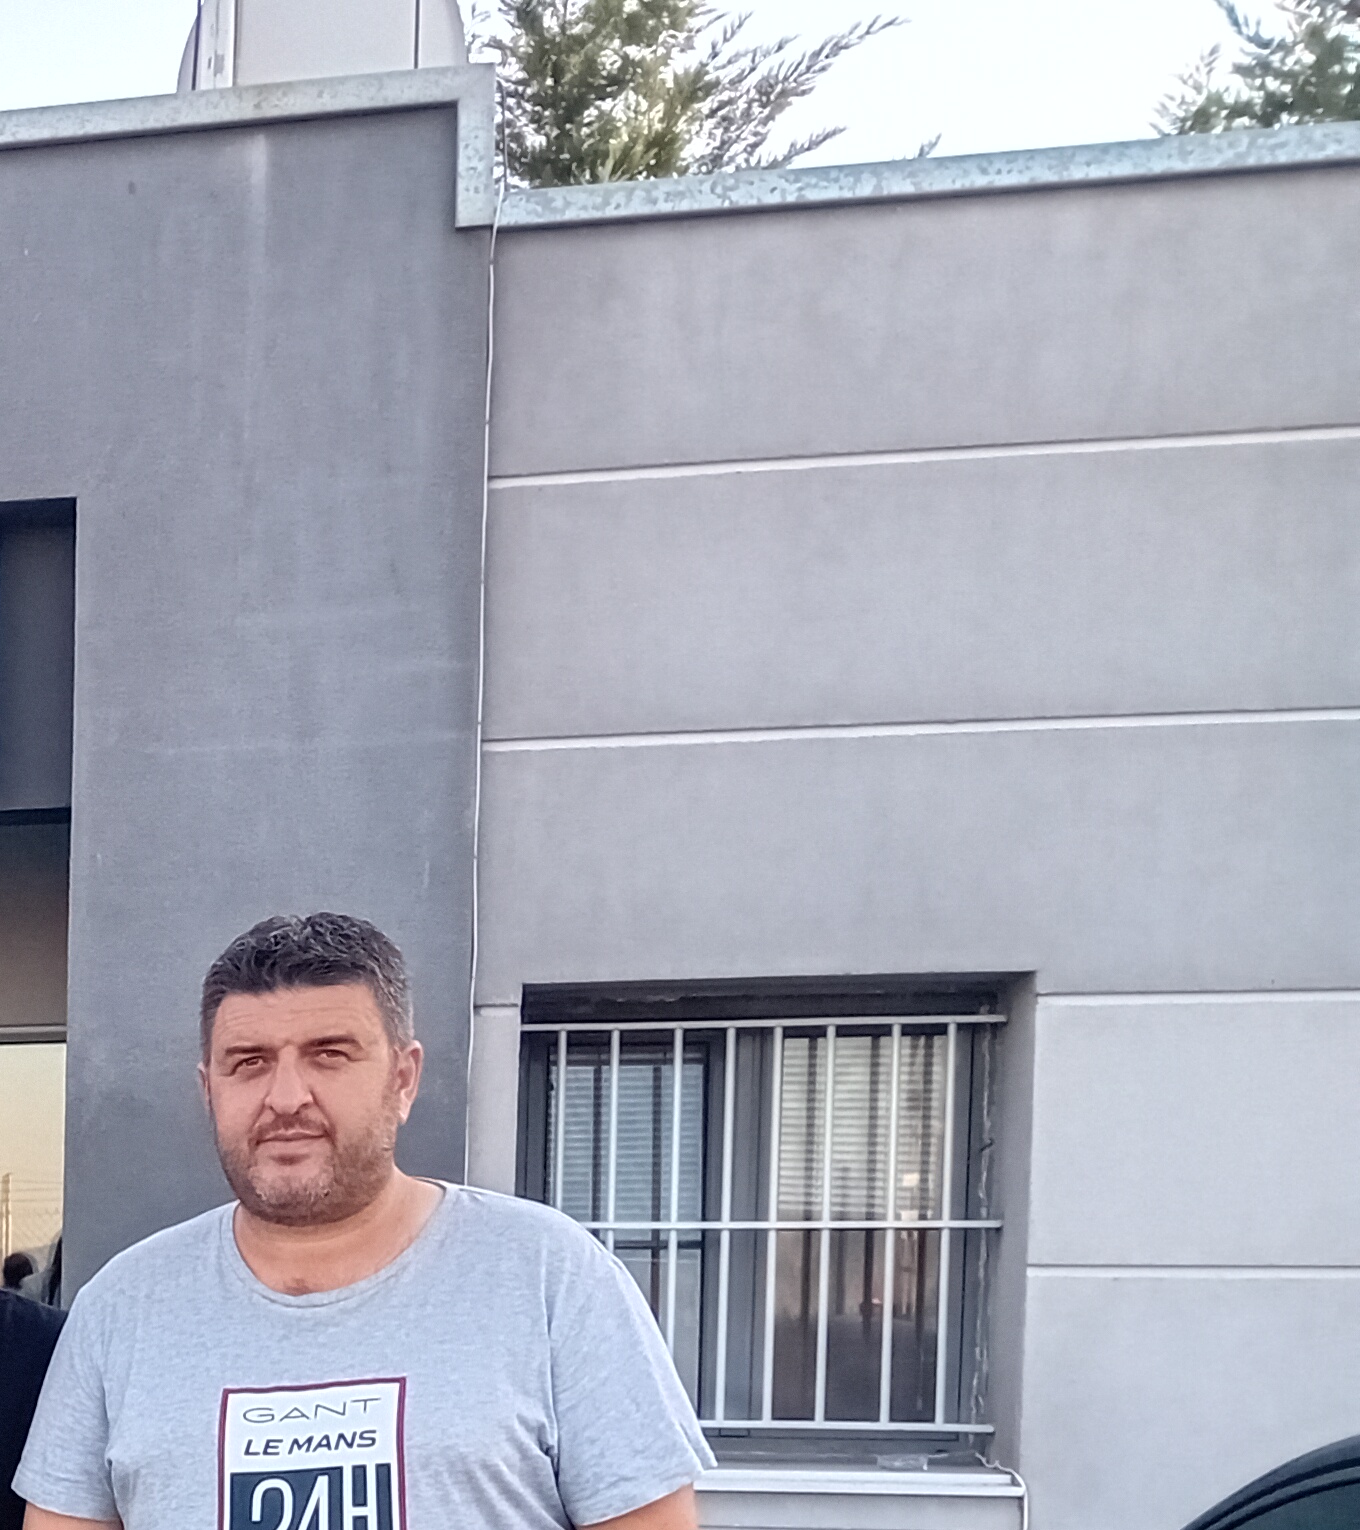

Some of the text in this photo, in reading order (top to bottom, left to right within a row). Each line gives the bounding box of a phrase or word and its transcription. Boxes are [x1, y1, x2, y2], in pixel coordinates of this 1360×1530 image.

[242, 1397, 382, 1424] GANT
[243, 1429, 378, 1456] LE MANS
